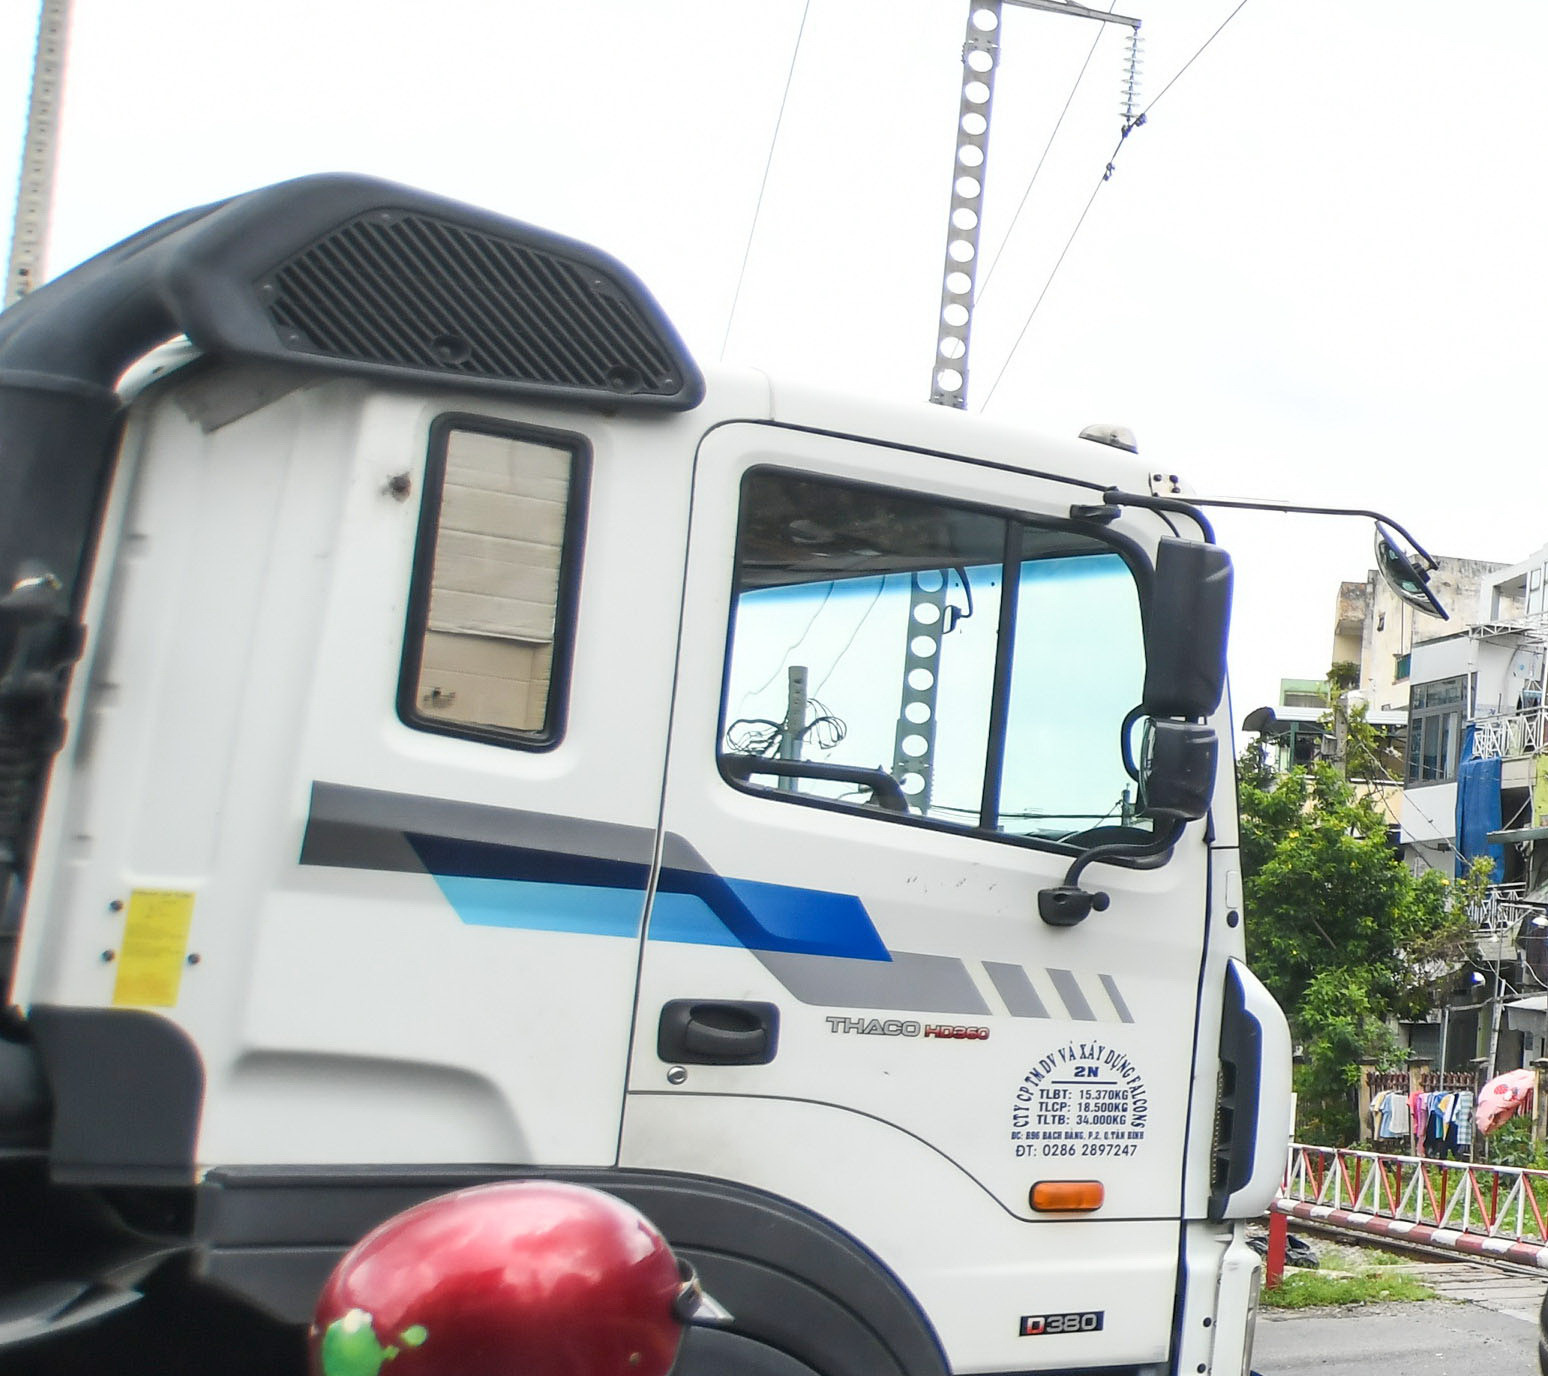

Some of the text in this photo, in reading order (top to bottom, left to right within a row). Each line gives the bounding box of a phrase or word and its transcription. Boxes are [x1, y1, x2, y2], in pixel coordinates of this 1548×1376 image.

[826, 1016, 990, 1040] THACO HD360
[1038, 1053, 1057, 1074] DV
[1073, 1066, 1099, 1078] 2N
[1024, 1067, 1045, 1087] TM
[1016, 1085, 1034, 1102] CP
[1039, 1089, 1129, 1100] TLBT: 15.370KG
[1126, 1075, 1148, 1128] FALCONS
[1038, 1101, 1129, 1112] TLCP: 18.500KG
[1013, 1104, 1030, 1128] CTY
[1037, 1114, 1127, 1125] TLTB: 34.000KG
[1015, 1144, 1138, 1157] ĐT: 0286 2897247
[1026, 1314, 1098, 1334] D380
